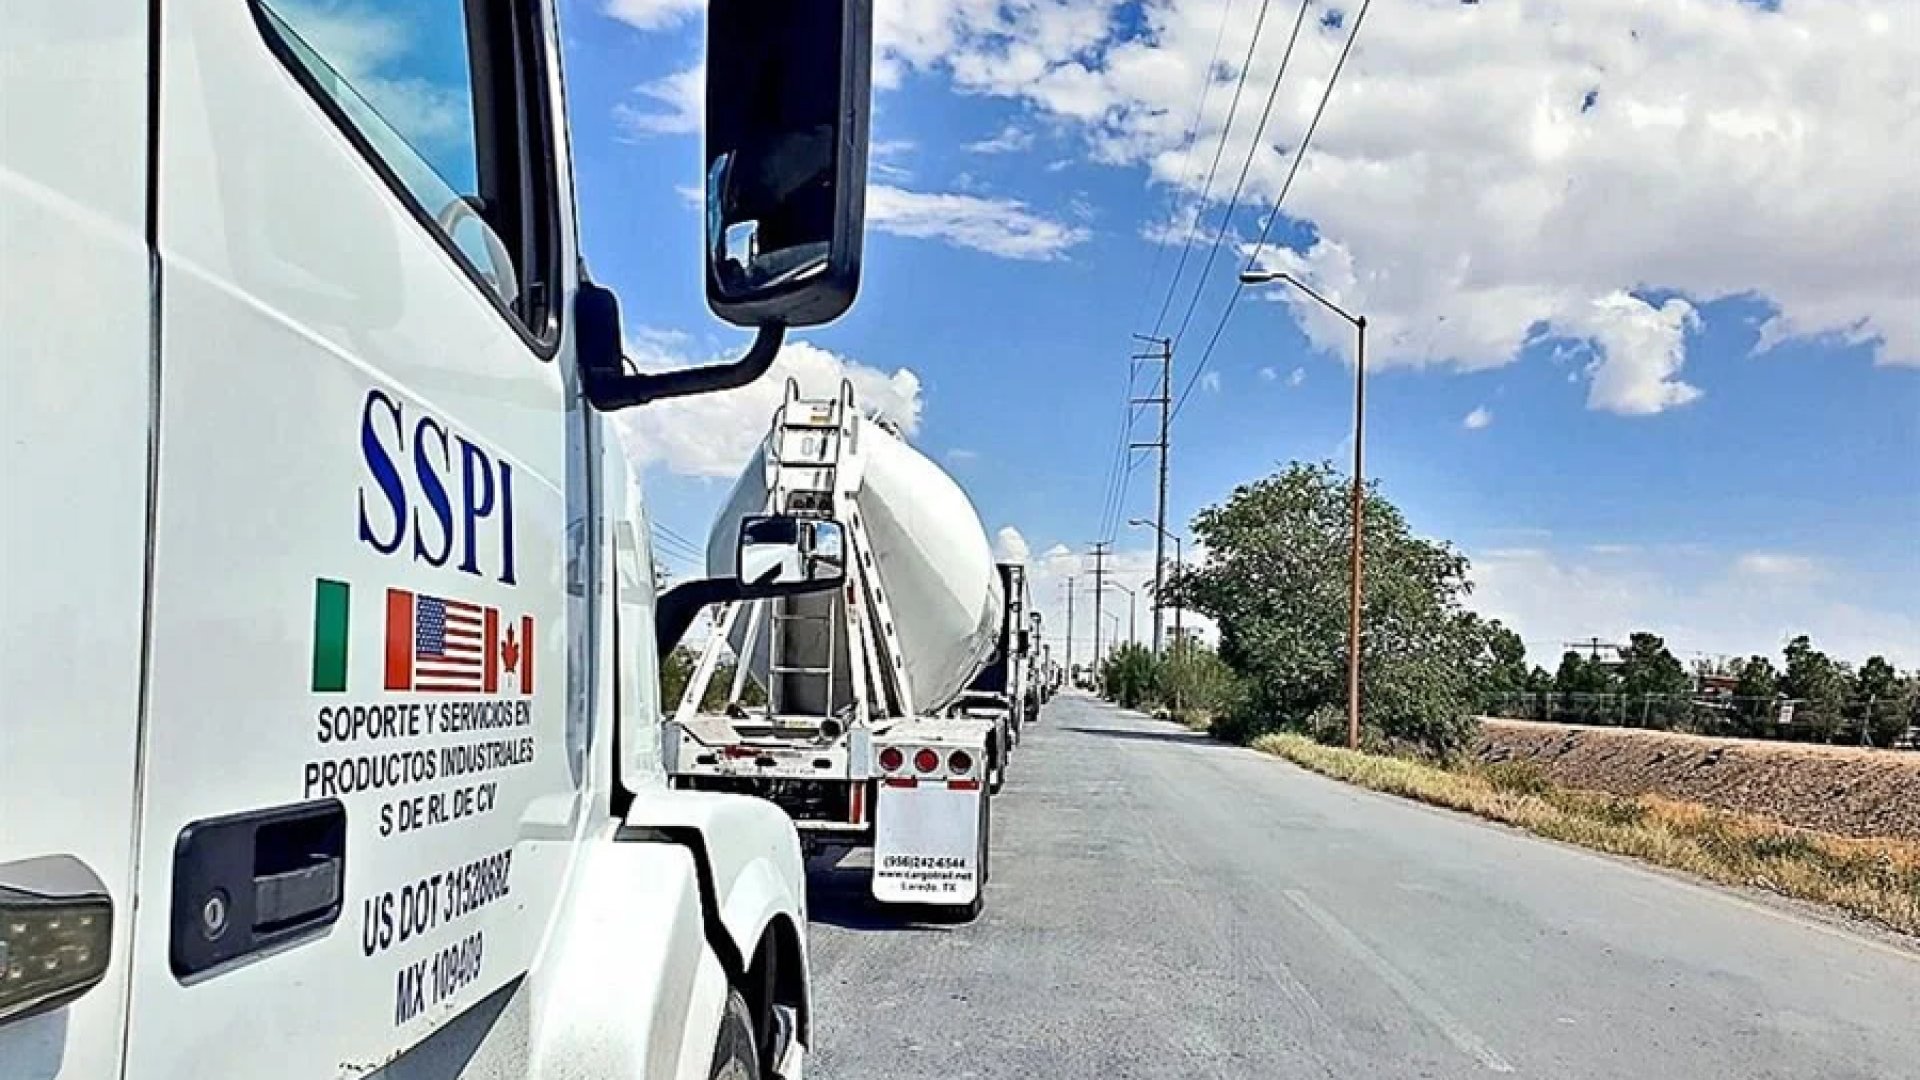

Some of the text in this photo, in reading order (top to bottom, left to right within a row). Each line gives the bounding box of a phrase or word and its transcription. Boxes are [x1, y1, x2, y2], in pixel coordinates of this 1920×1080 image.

[358, 389, 516, 585] SSPI
[318, 700, 532, 743] SOPORTE Y SERVICIOS EN
[304, 737, 535, 798] PRODUCTOS INDUSTRIALES
[379, 782, 498, 836] S DE RL DE CV
[363, 891, 394, 957] US
[399, 874, 443, 942] DOT
[942, 883, 957, 892] TX
[395, 958, 427, 1027] MX
